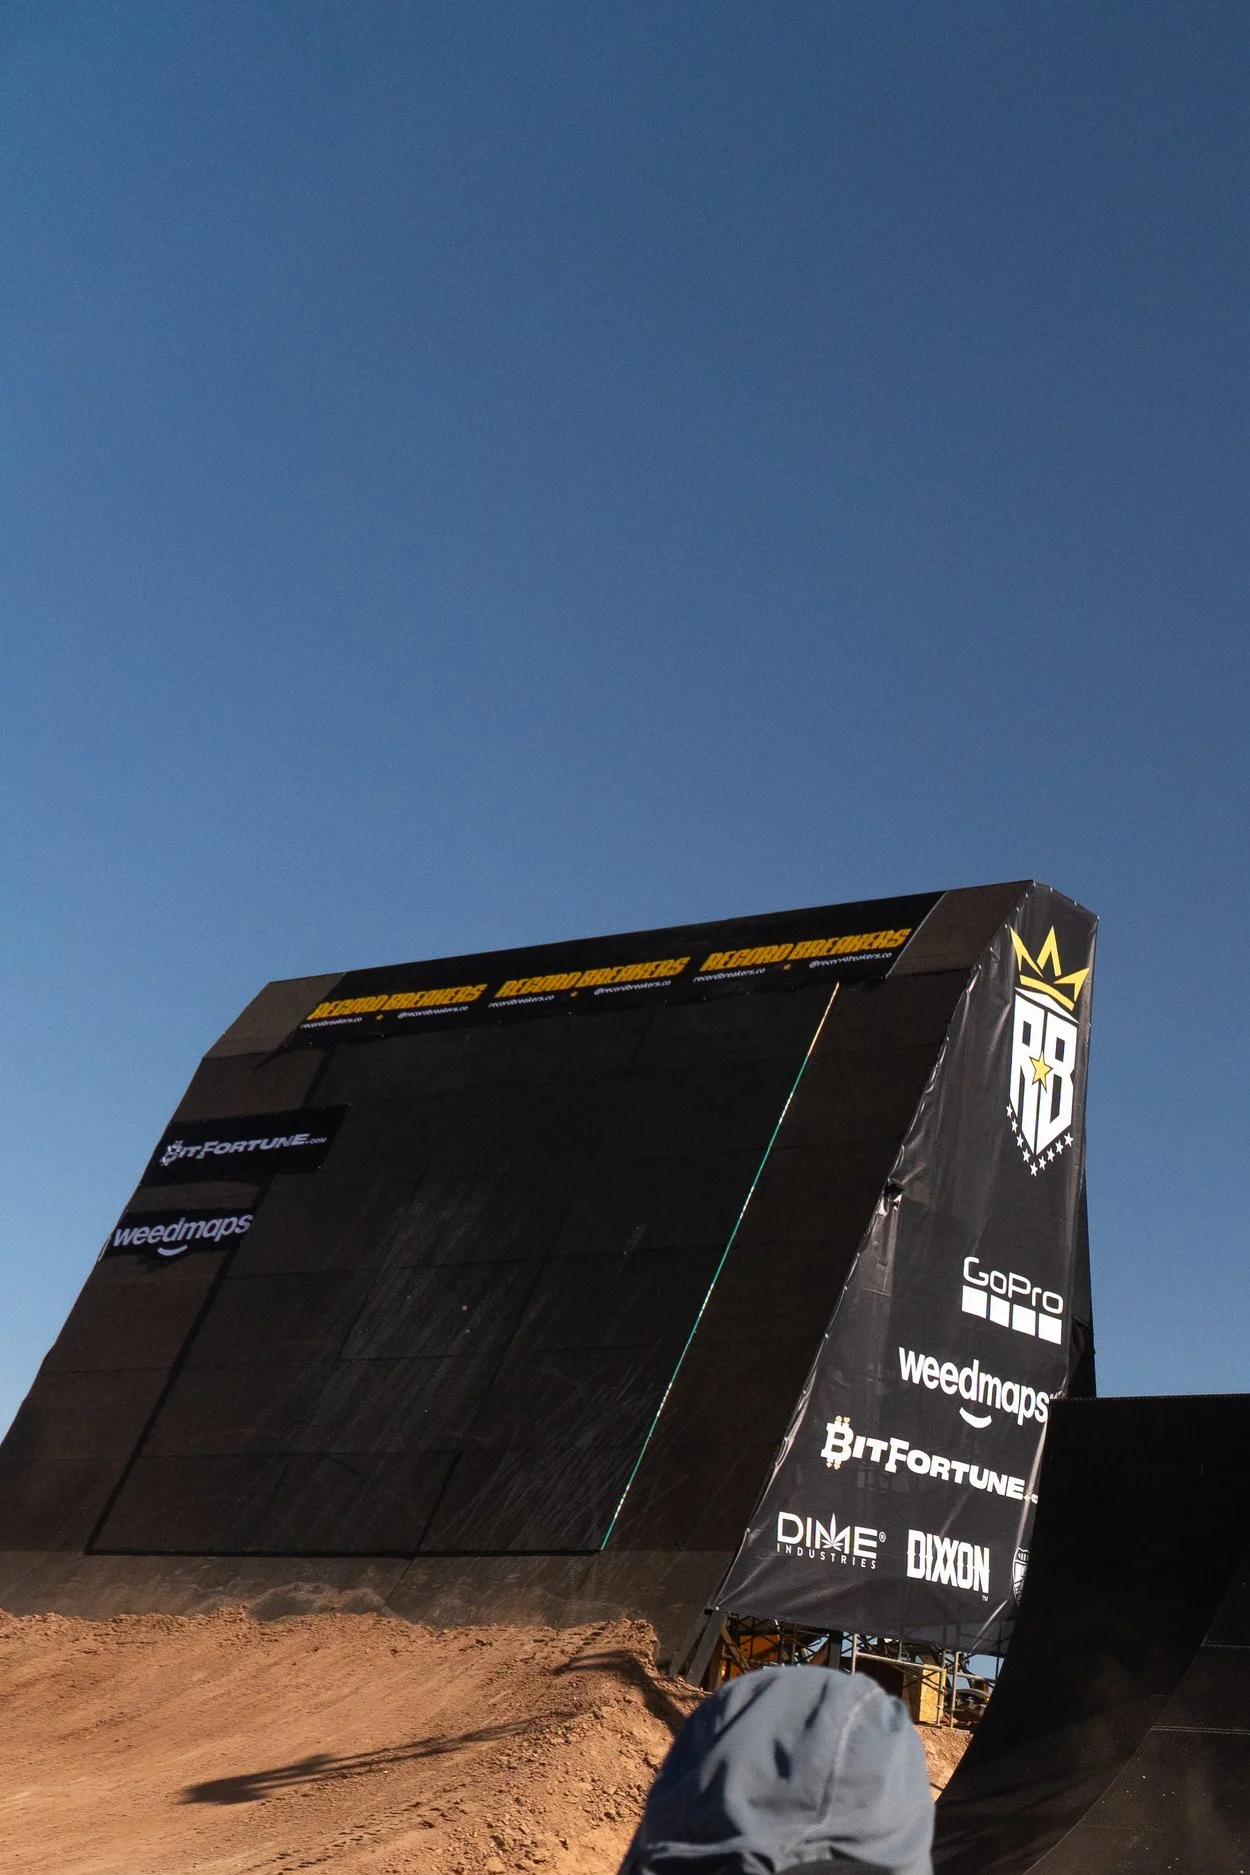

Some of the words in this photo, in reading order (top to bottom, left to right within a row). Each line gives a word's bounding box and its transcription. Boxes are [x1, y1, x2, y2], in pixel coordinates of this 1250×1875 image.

[700, 943, 794, 972] RECORD
[787, 928, 912, 961] BREAKERS
[494, 971, 582, 999] RECORD
[575, 956, 691, 988] BREAKERS
[307, 994, 388, 1021] RECORD
[381, 984, 487, 1011] BREAKERS
[112, 1212, 254, 1247] weedmaps
[963, 1256, 1064, 1314] GoPro
[898, 1346, 1049, 1425] weedmaps
[776, 1543, 876, 1570] INDUSTRIES
[777, 1511, 878, 1560] DIME
[907, 1529, 990, 1594] DIXXON
